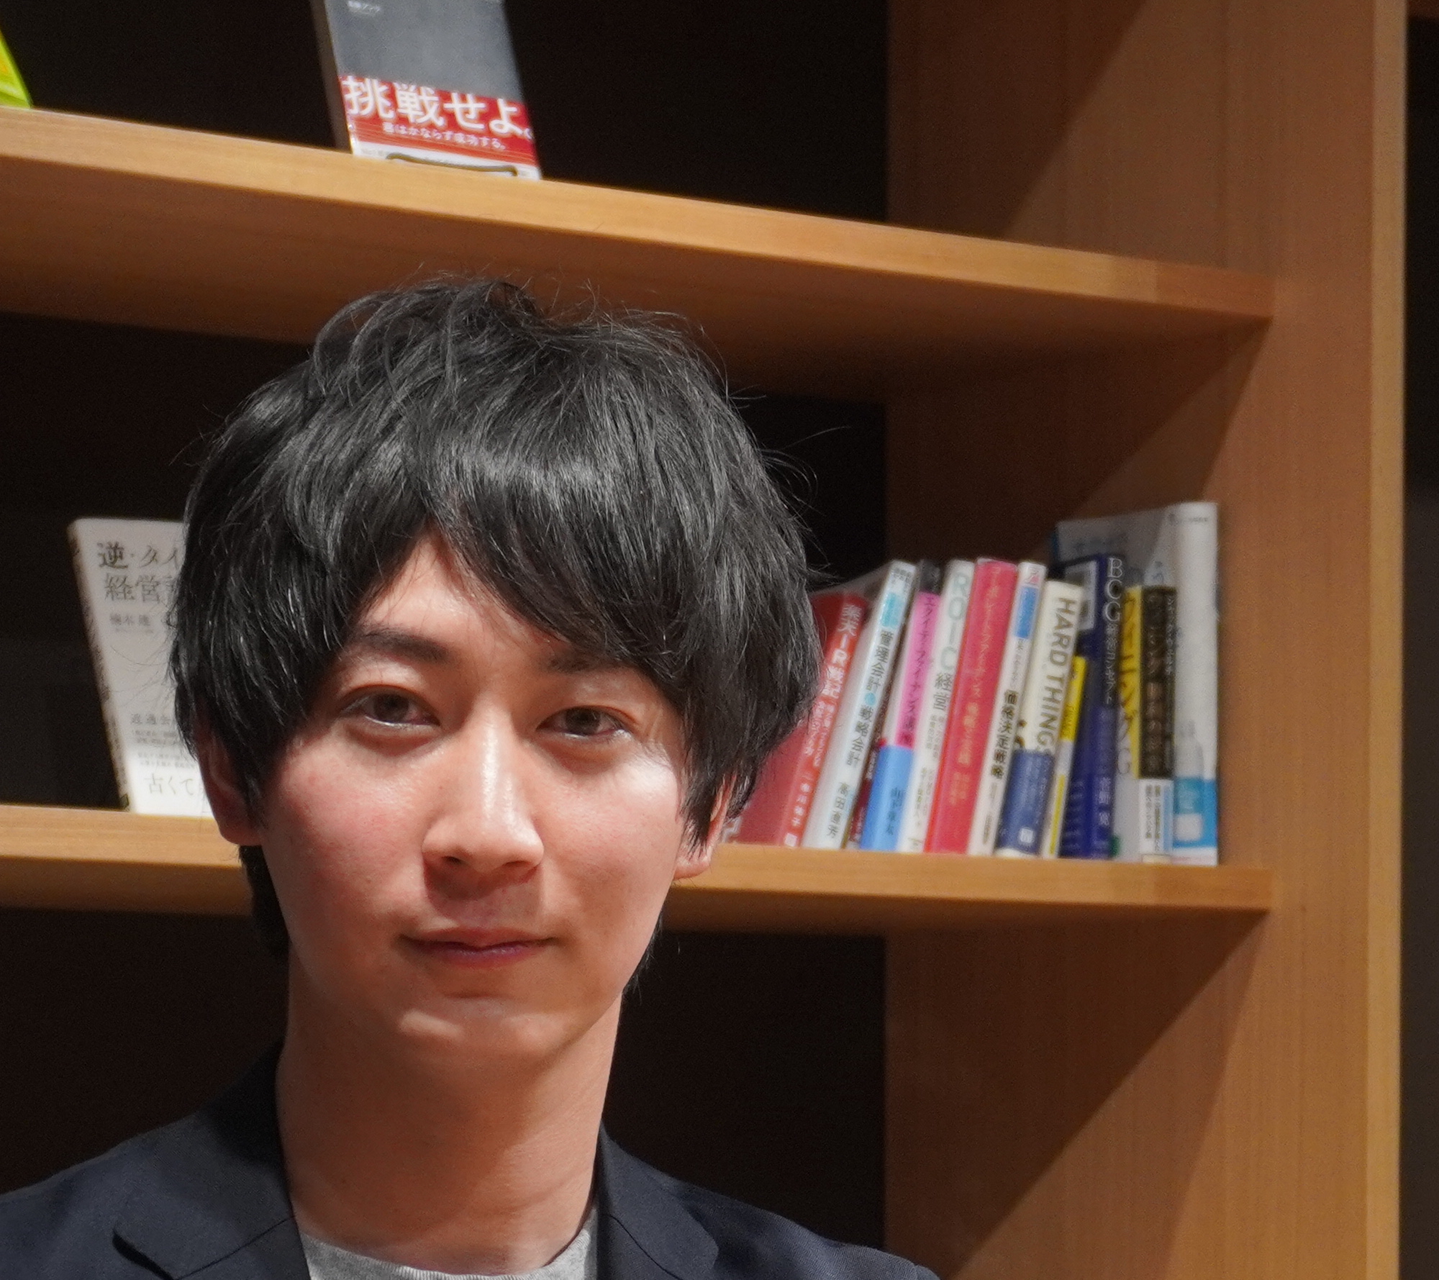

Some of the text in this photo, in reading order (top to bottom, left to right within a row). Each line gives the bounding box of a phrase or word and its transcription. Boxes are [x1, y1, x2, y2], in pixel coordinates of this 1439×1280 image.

[341, 76, 535, 141] 挑戦せよ。
[1048, 597, 1078, 667] HARD
[845, 630, 894, 768] 管理会計 戦略会計
[145, 773, 194, 796] 古くて
